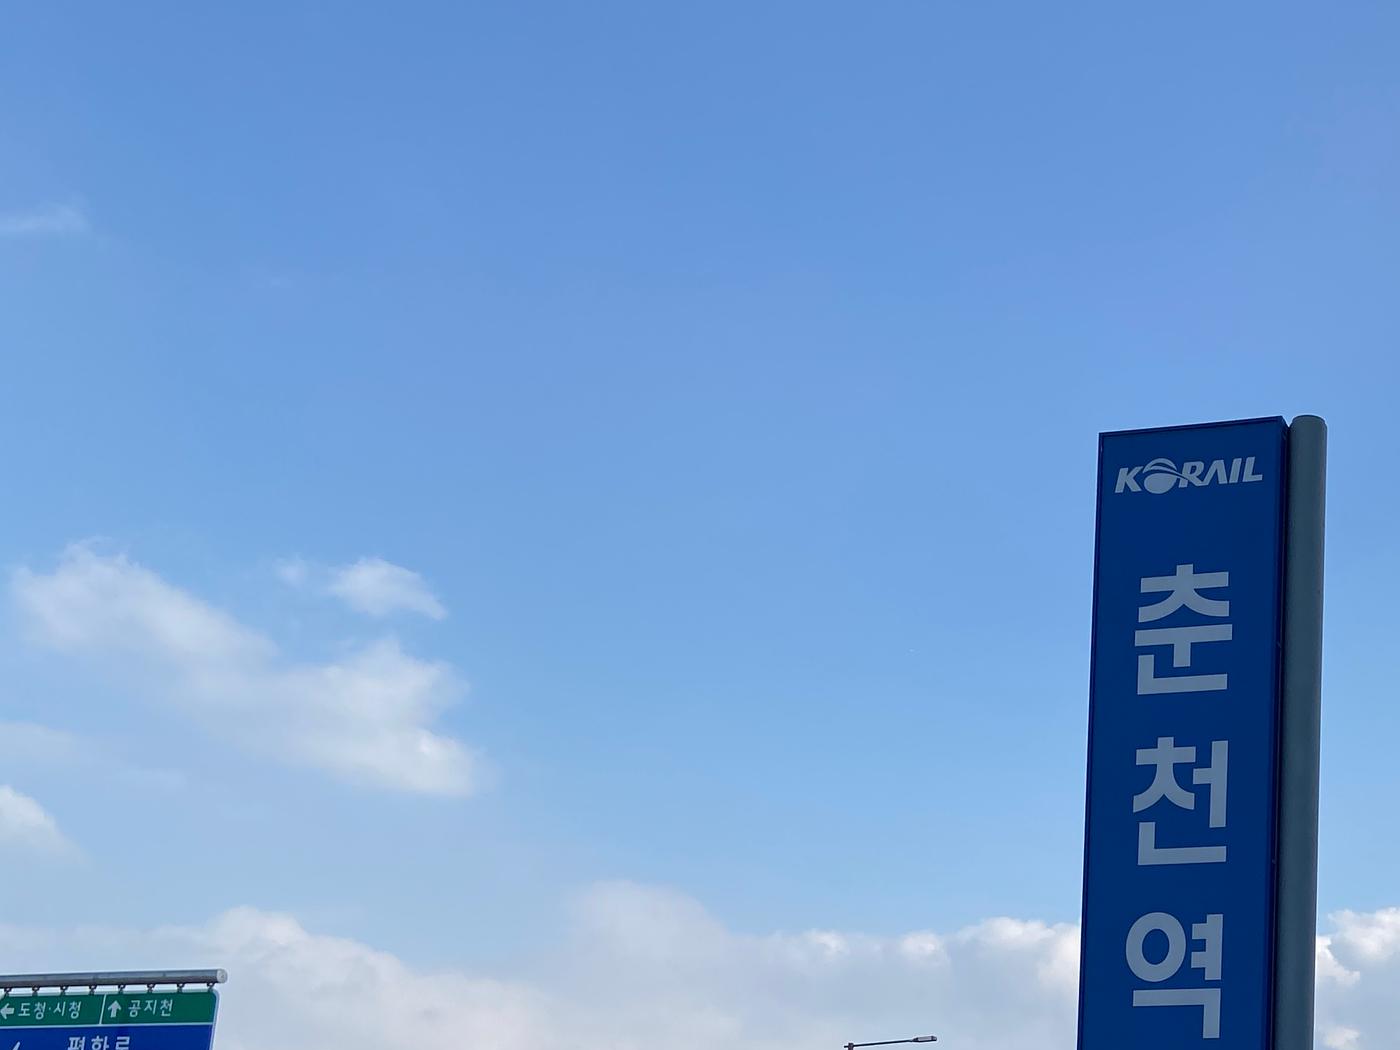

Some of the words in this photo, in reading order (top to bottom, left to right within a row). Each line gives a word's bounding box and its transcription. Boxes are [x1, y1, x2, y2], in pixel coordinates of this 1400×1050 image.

[1115, 456, 1263, 494] KORAIL
[1125, 563, 1233, 1039] 춘천역
[128, 999, 174, 1018] 공지천
